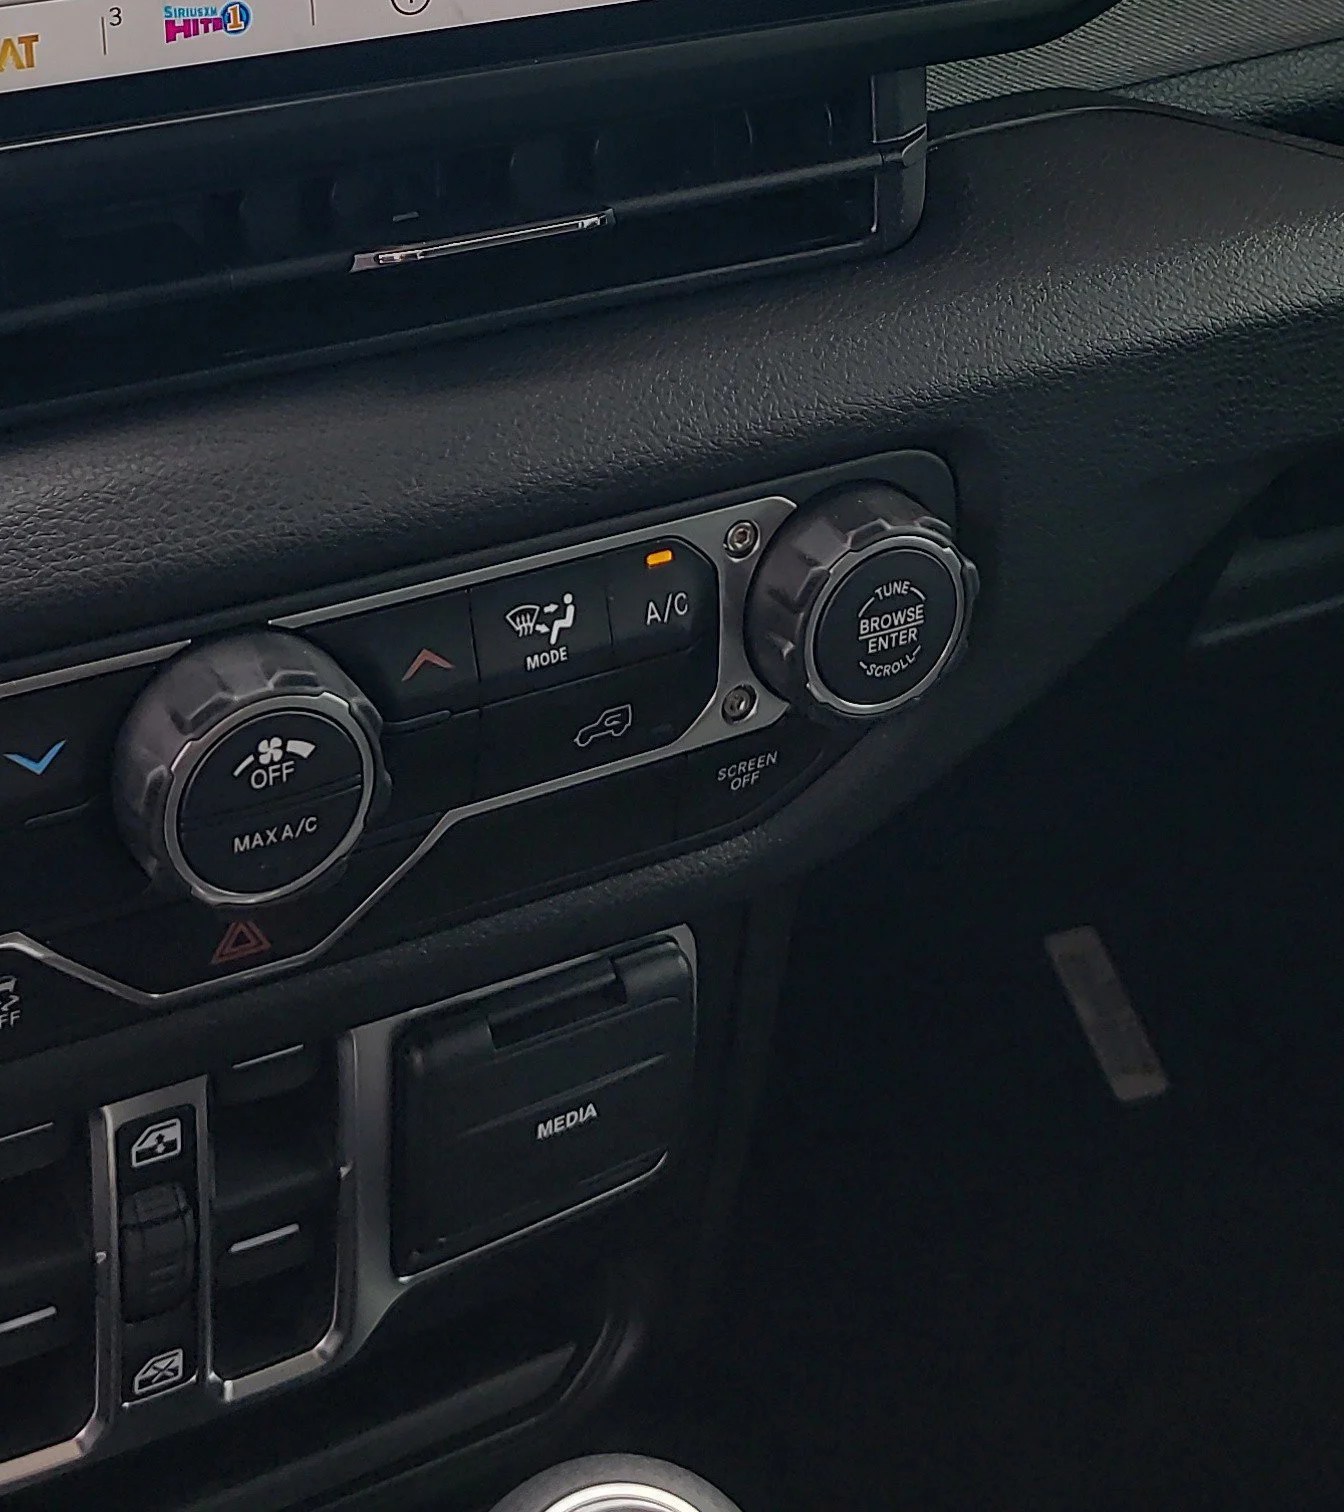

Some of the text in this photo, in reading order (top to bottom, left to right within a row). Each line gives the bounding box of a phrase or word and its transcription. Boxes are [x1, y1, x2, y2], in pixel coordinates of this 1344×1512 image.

[109, 6, 123, 26] 3
[874, 580, 911, 601] TUNE
[645, 591, 689, 626] A/C
[858, 604, 925, 635] BROWSE
[867, 627, 918, 654] ENTER
[525, 646, 568, 672] MODE
[865, 652, 917, 678] SCROLL
[249, 760, 296, 790] OFF
[717, 751, 778, 783] SCREEN
[730, 772, 760, 791] OFF
[233, 816, 319, 855] MAX A/C
[536, 1101, 598, 1140] MEDIA
